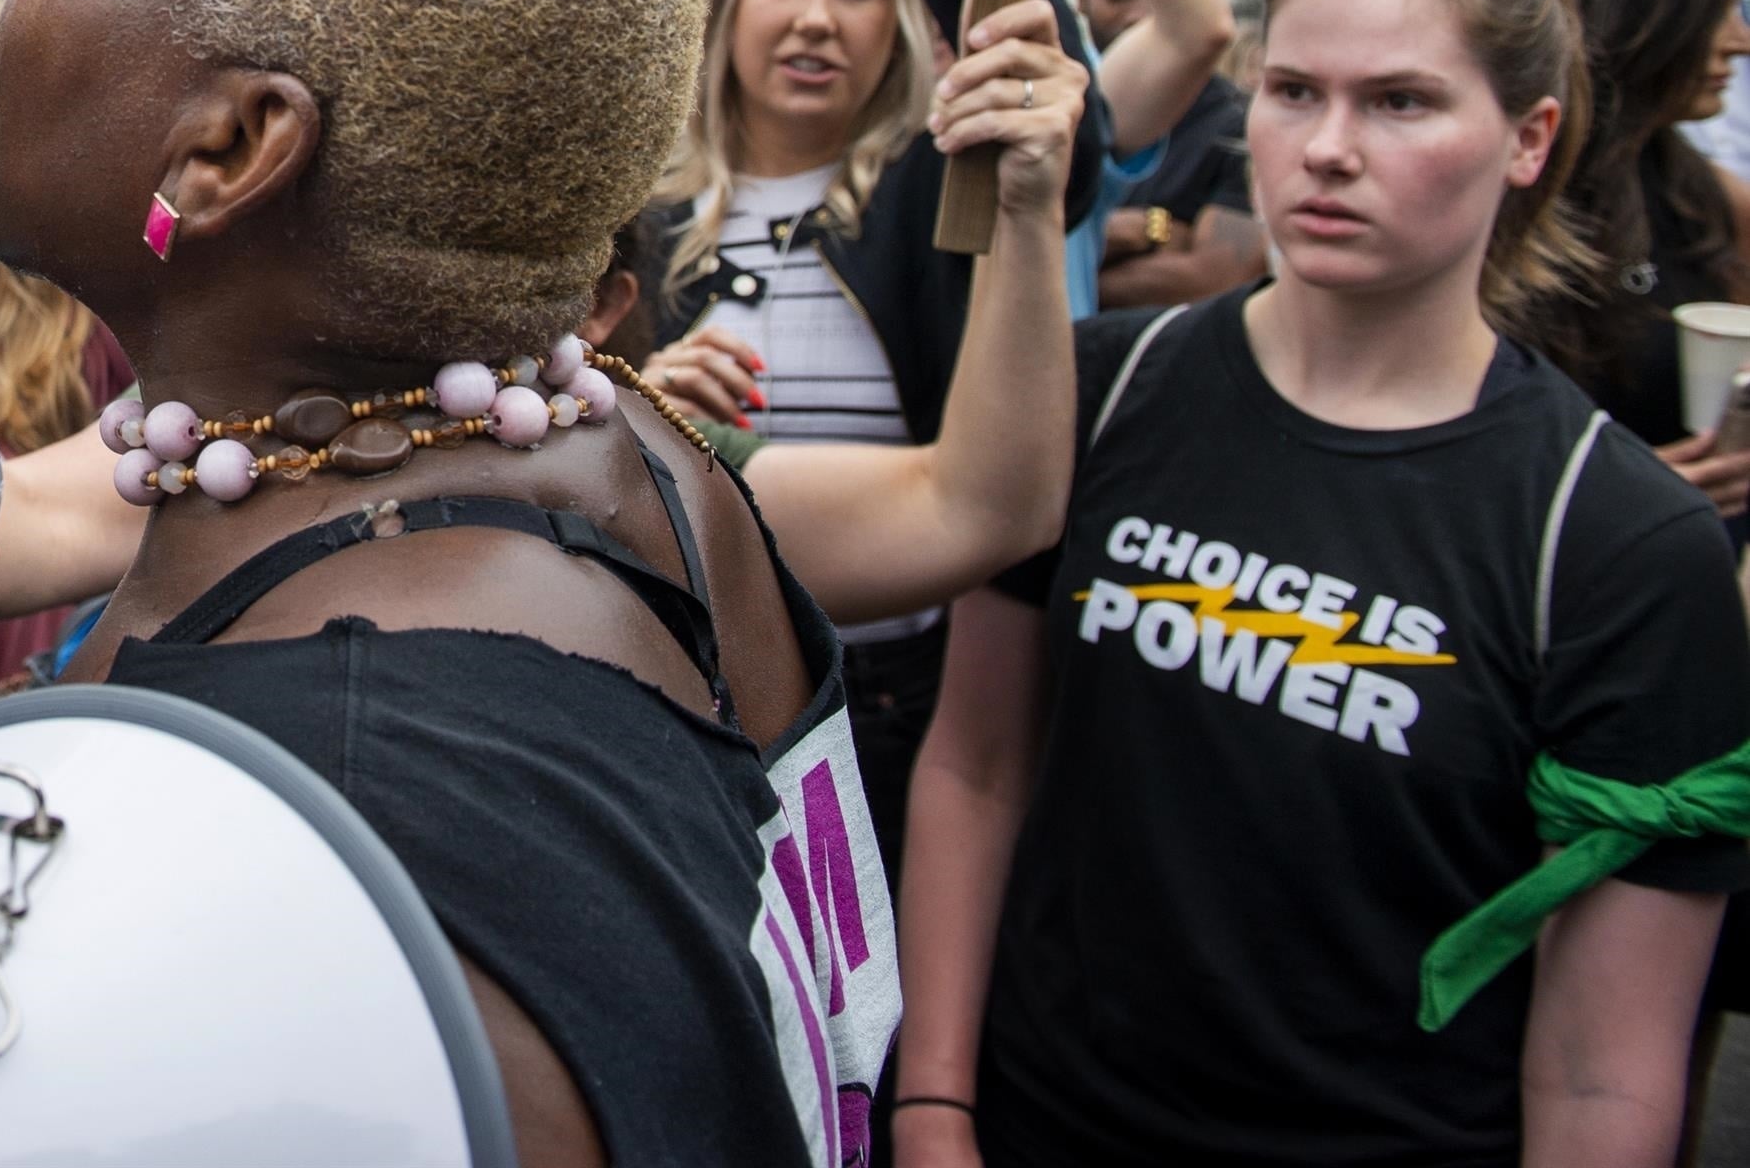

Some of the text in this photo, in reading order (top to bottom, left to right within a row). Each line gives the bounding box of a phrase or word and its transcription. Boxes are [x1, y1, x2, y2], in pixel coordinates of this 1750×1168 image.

[1105, 516, 1447, 657] CHOICE IS
[1078, 578, 1421, 758] POWER
